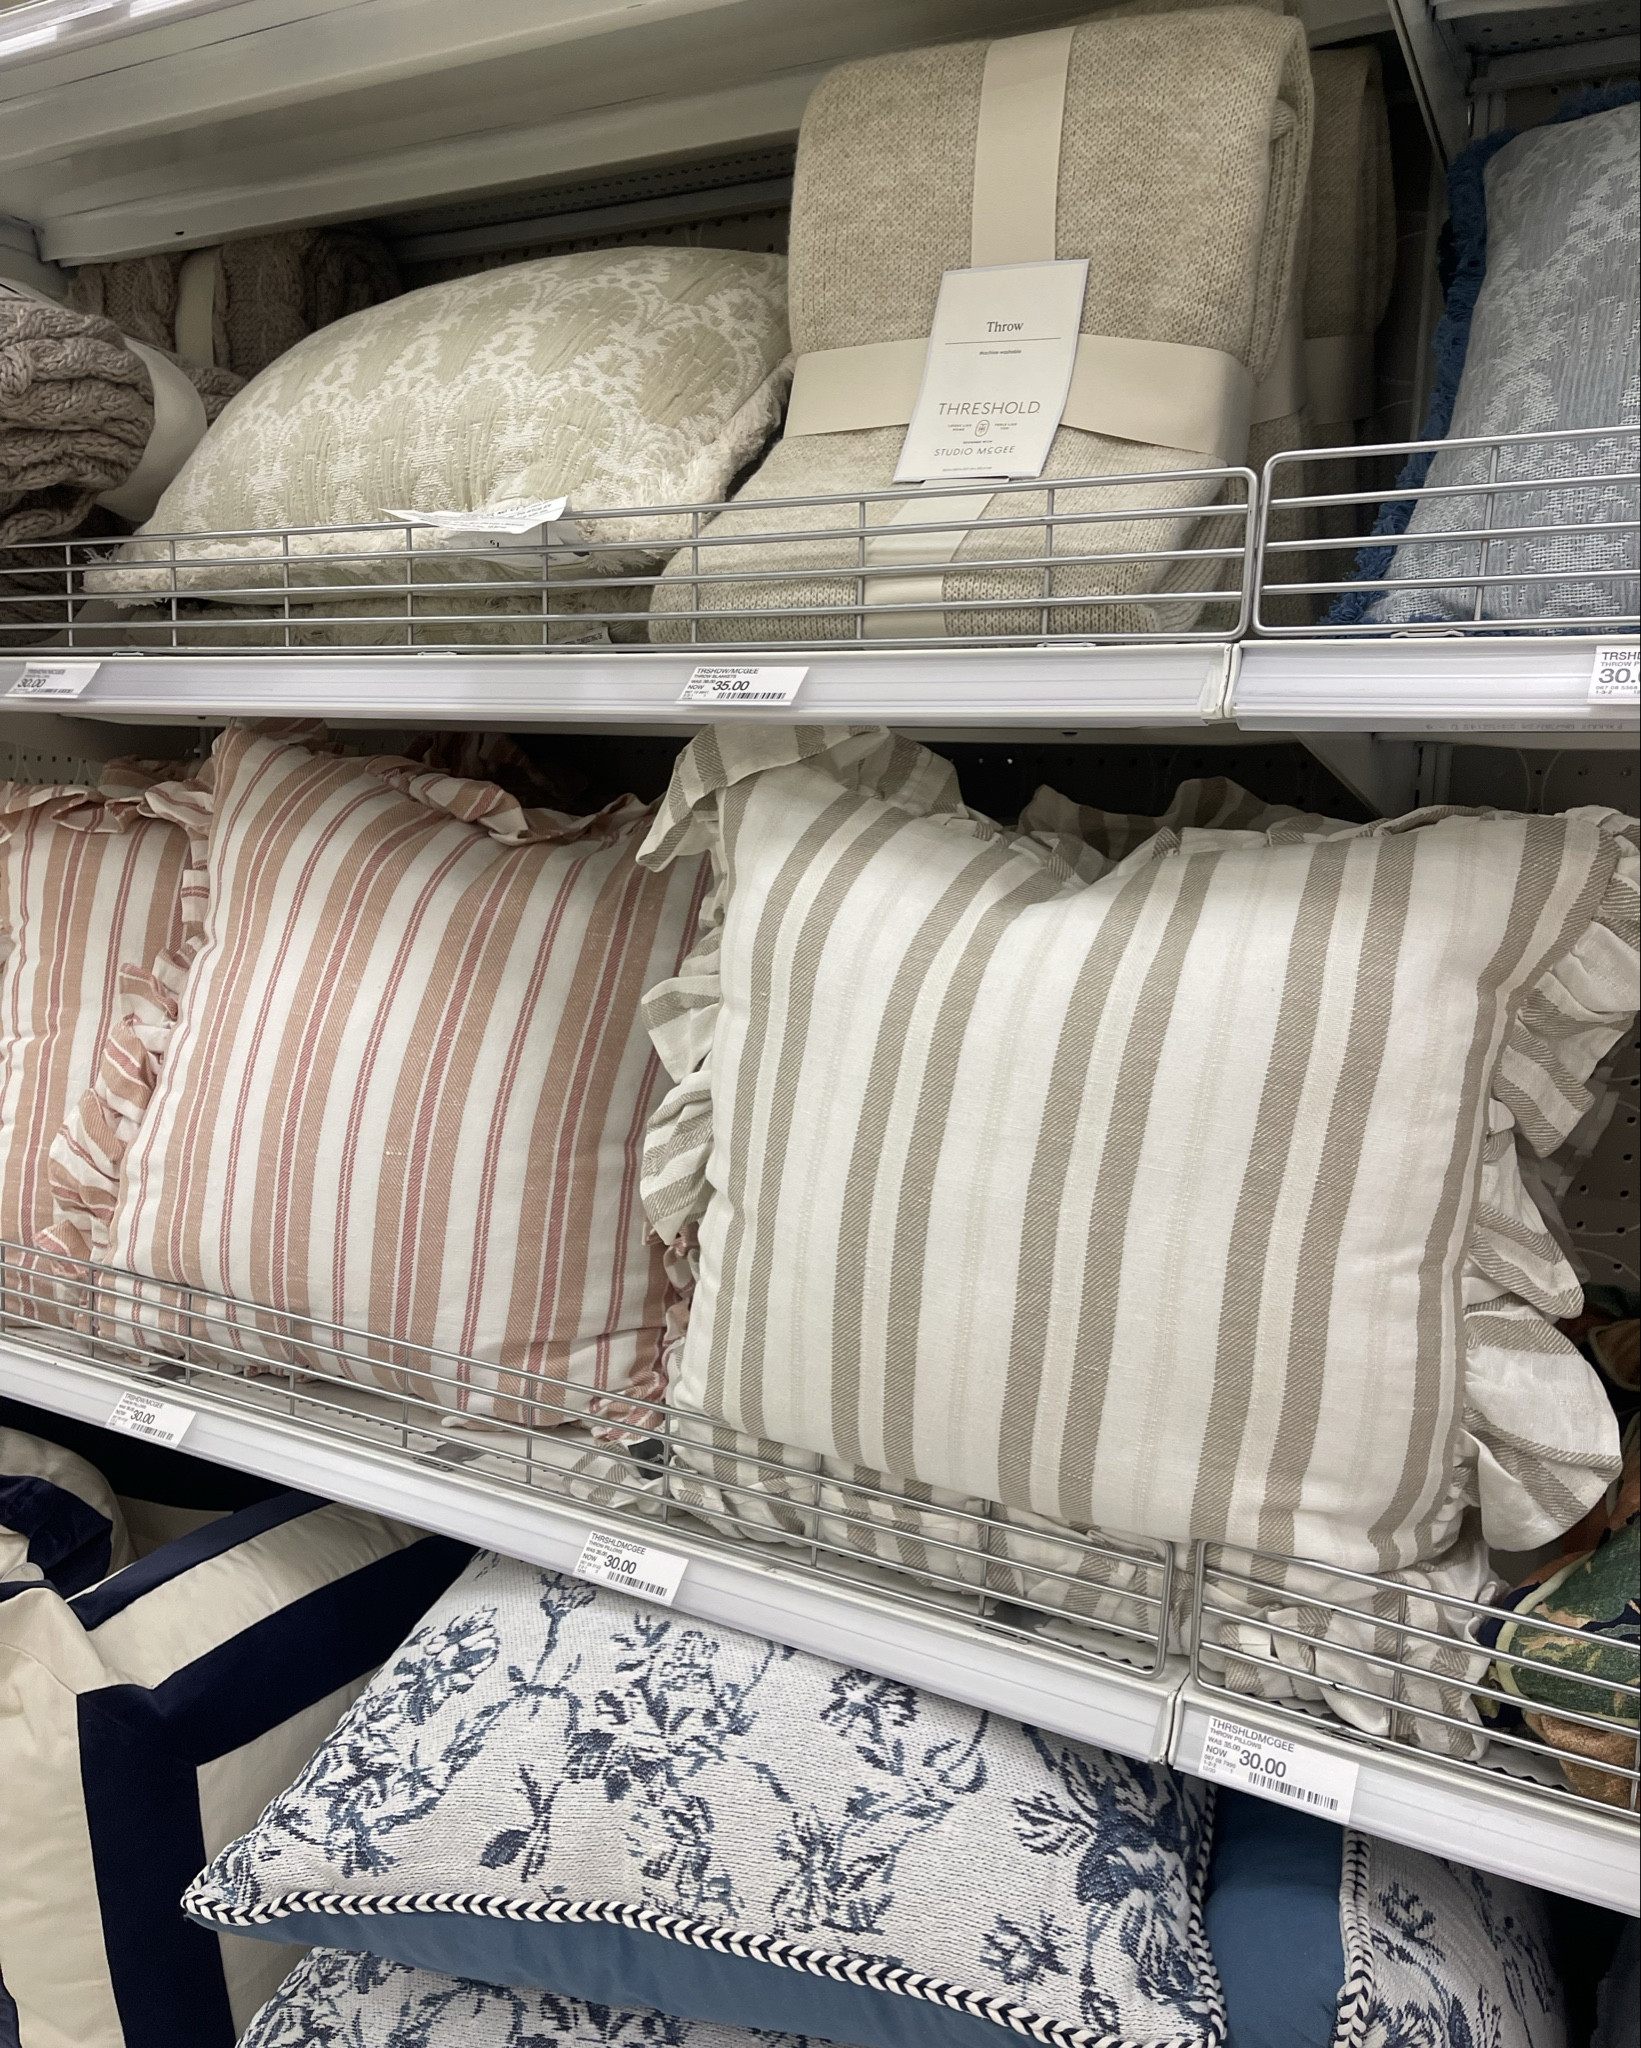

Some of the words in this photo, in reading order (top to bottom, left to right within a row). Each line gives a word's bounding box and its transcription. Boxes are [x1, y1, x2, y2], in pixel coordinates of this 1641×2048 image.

[986, 321, 1024, 333] Throw
[939, 401, 1041, 415] THRESHOLD
[934, 447, 974, 457] STUDIO
[17, 678, 47, 688] 30.00
[1598, 668, 1640, 684] 30.
[712, 680, 750, 691] 35.00
[130, 1409, 156, 1425] 30.00
[591, 1532, 647, 1555] THRSHLDMCGEE
[582, 1553, 598, 1562] NOW
[604, 1554, 637, 1575] 30.00
[1207, 1736, 1223, 1746] WAS
[1209, 1727, 1233, 1740] THROW
[1233, 1736, 1262, 1750] PILLOWS
[1211, 1718, 1296, 1753] THRSHLDMCGEE
[1205, 1744, 1228, 1758] NOW
[1238, 1749, 1287, 1778] 30.00
